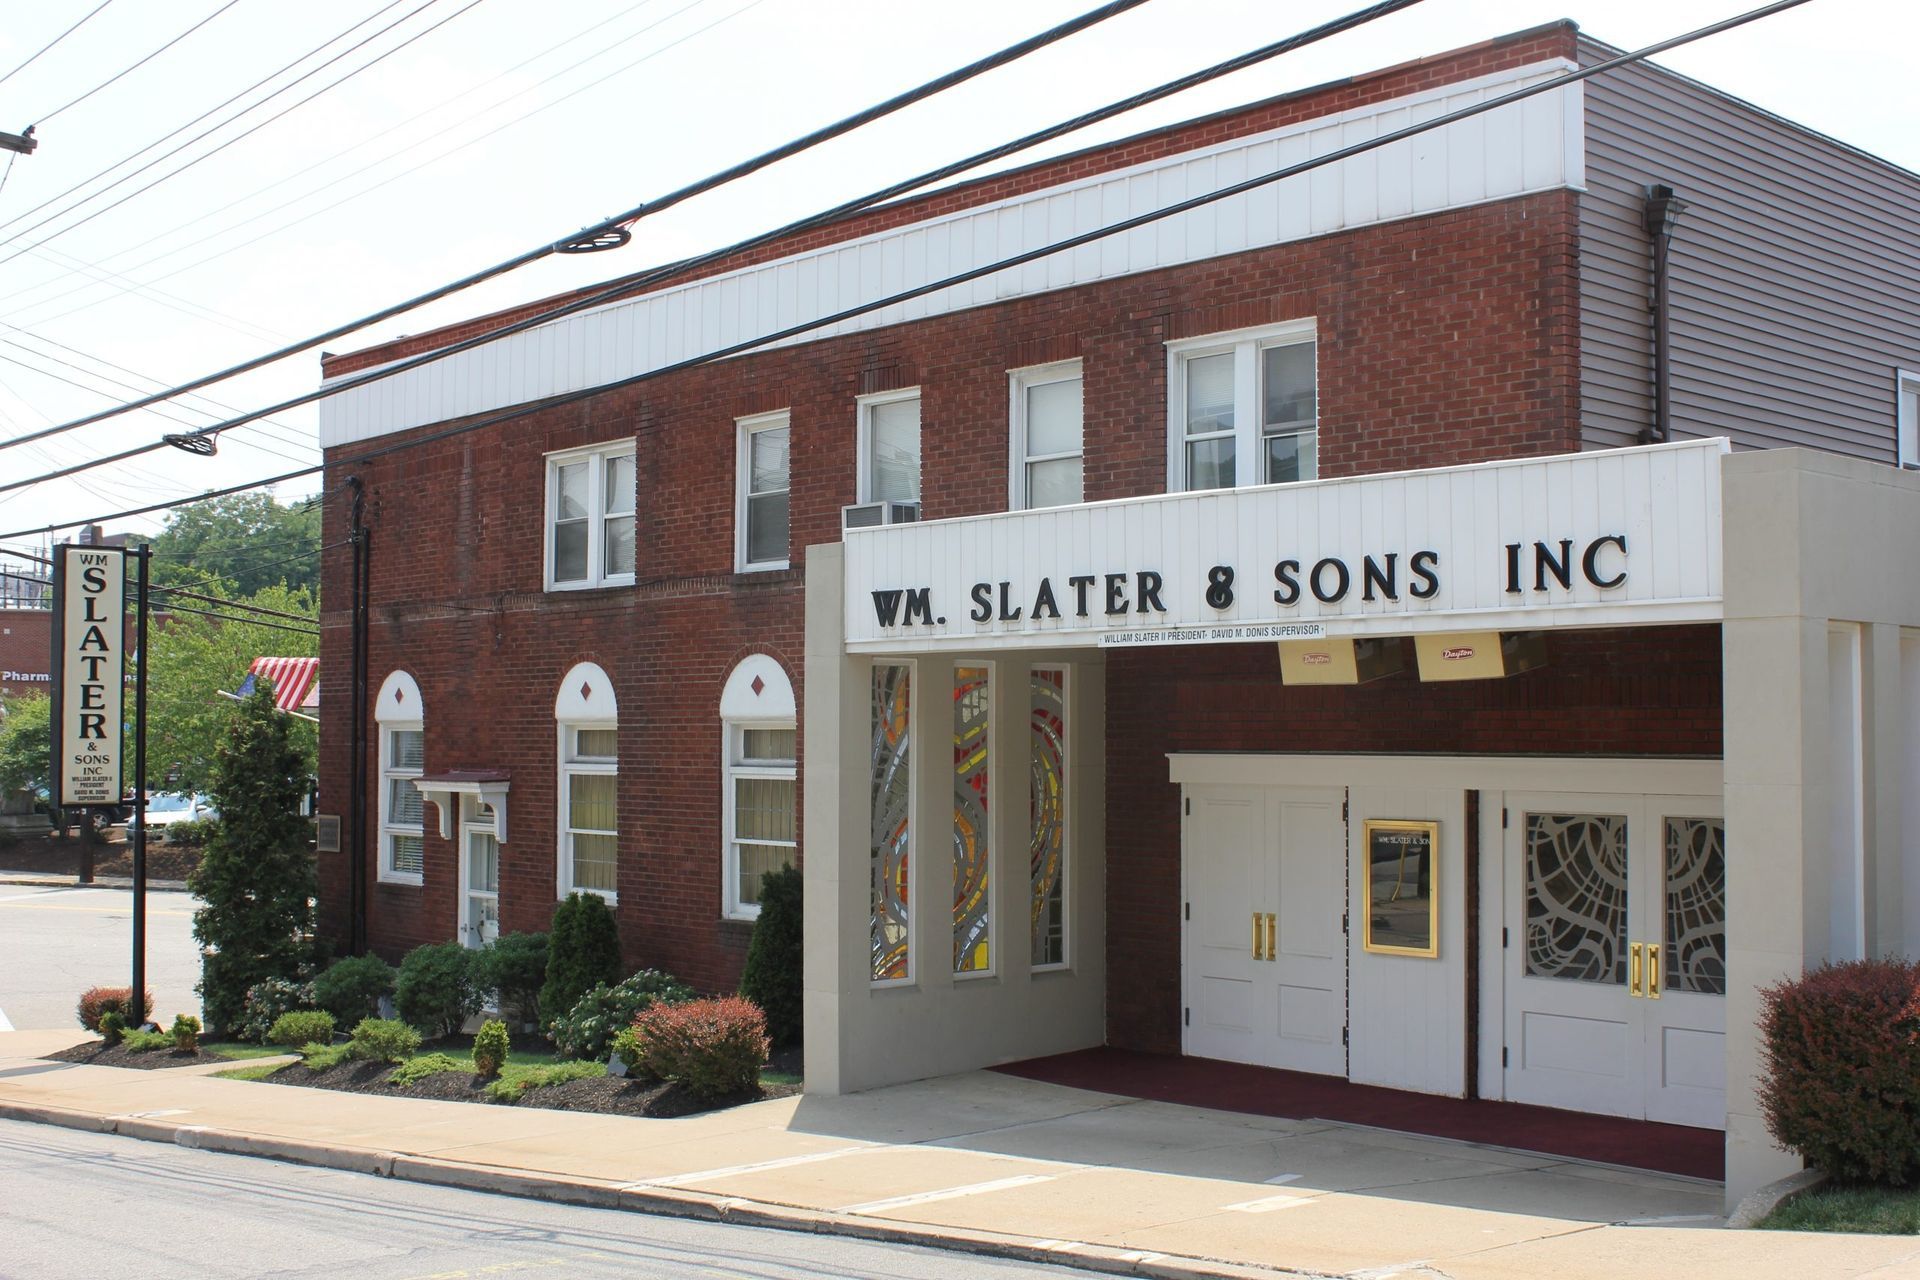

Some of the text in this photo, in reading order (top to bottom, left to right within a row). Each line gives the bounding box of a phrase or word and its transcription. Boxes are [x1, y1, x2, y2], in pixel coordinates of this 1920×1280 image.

[80, 554, 108, 566] WM
[871, 588, 946, 627] WM.
[971, 571, 1167, 623] SLATER
[1273, 550, 1440, 606] SONS
[1504, 534, 1627, 593] INC
[1104, 624, 1320, 643] WILLIAM SLATER II PRESIDENT DAVID M. DONIS SUPERVISOR
[79, 567, 109, 739] SLATER
[1444, 648, 1473, 660] Dayton
[1303, 655, 1330, 664] Dayton
[87, 741, 97, 751] &
[74, 754, 110, 765] SONS
[83, 766, 103, 775] INC
